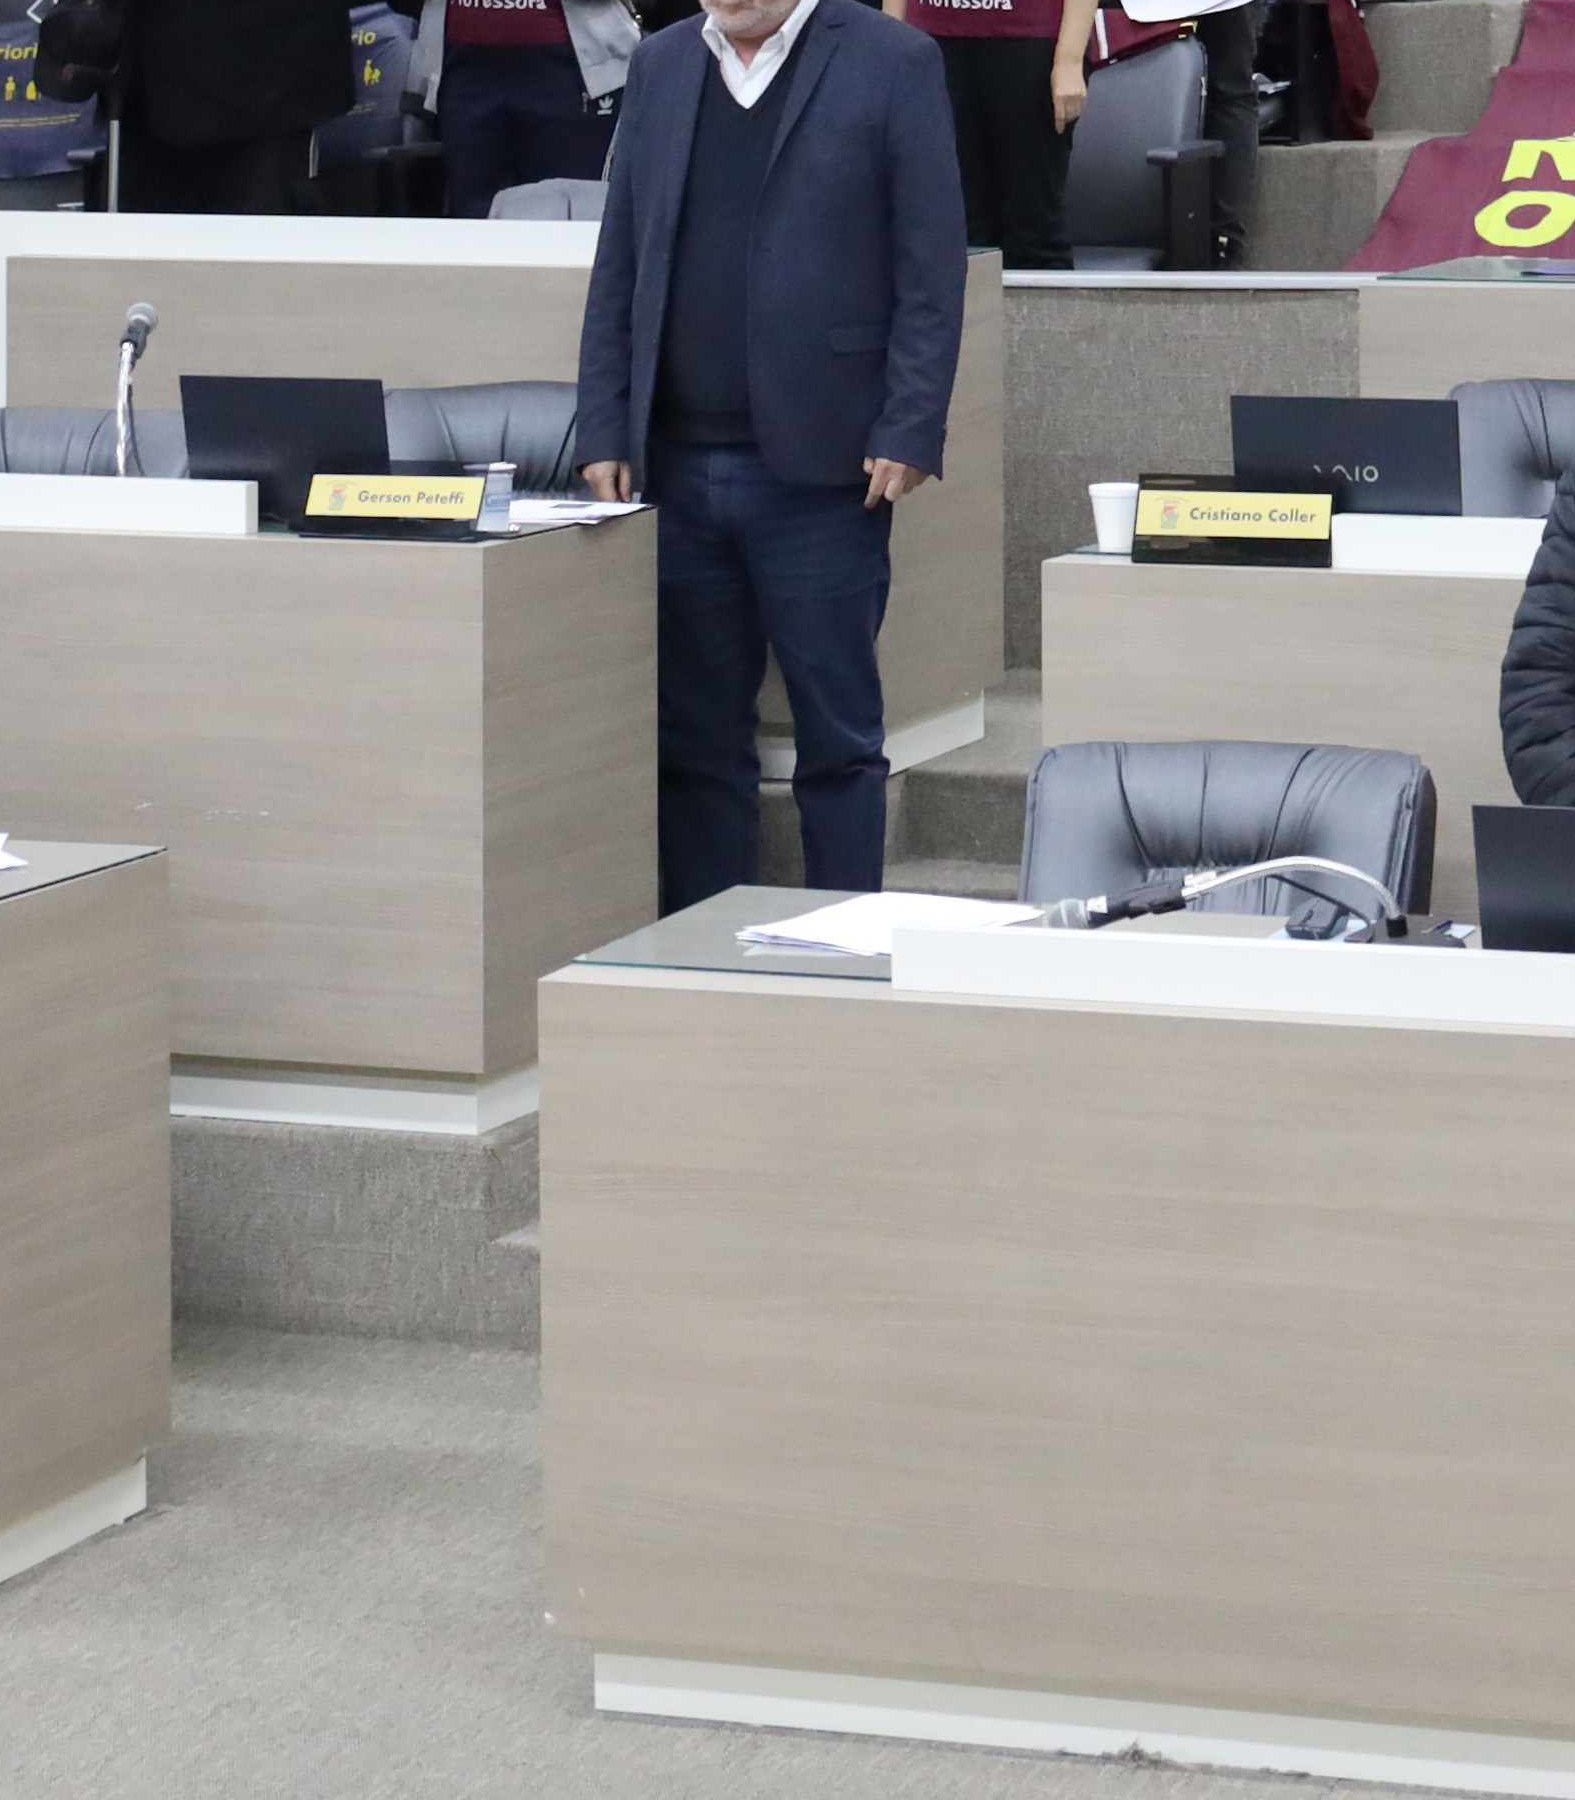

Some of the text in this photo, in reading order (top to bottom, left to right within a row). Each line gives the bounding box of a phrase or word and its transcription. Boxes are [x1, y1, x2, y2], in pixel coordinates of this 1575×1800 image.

[358, 490, 464, 504] Gerson Peteffi
[1189, 507, 1316, 523] Cristiano Coller
